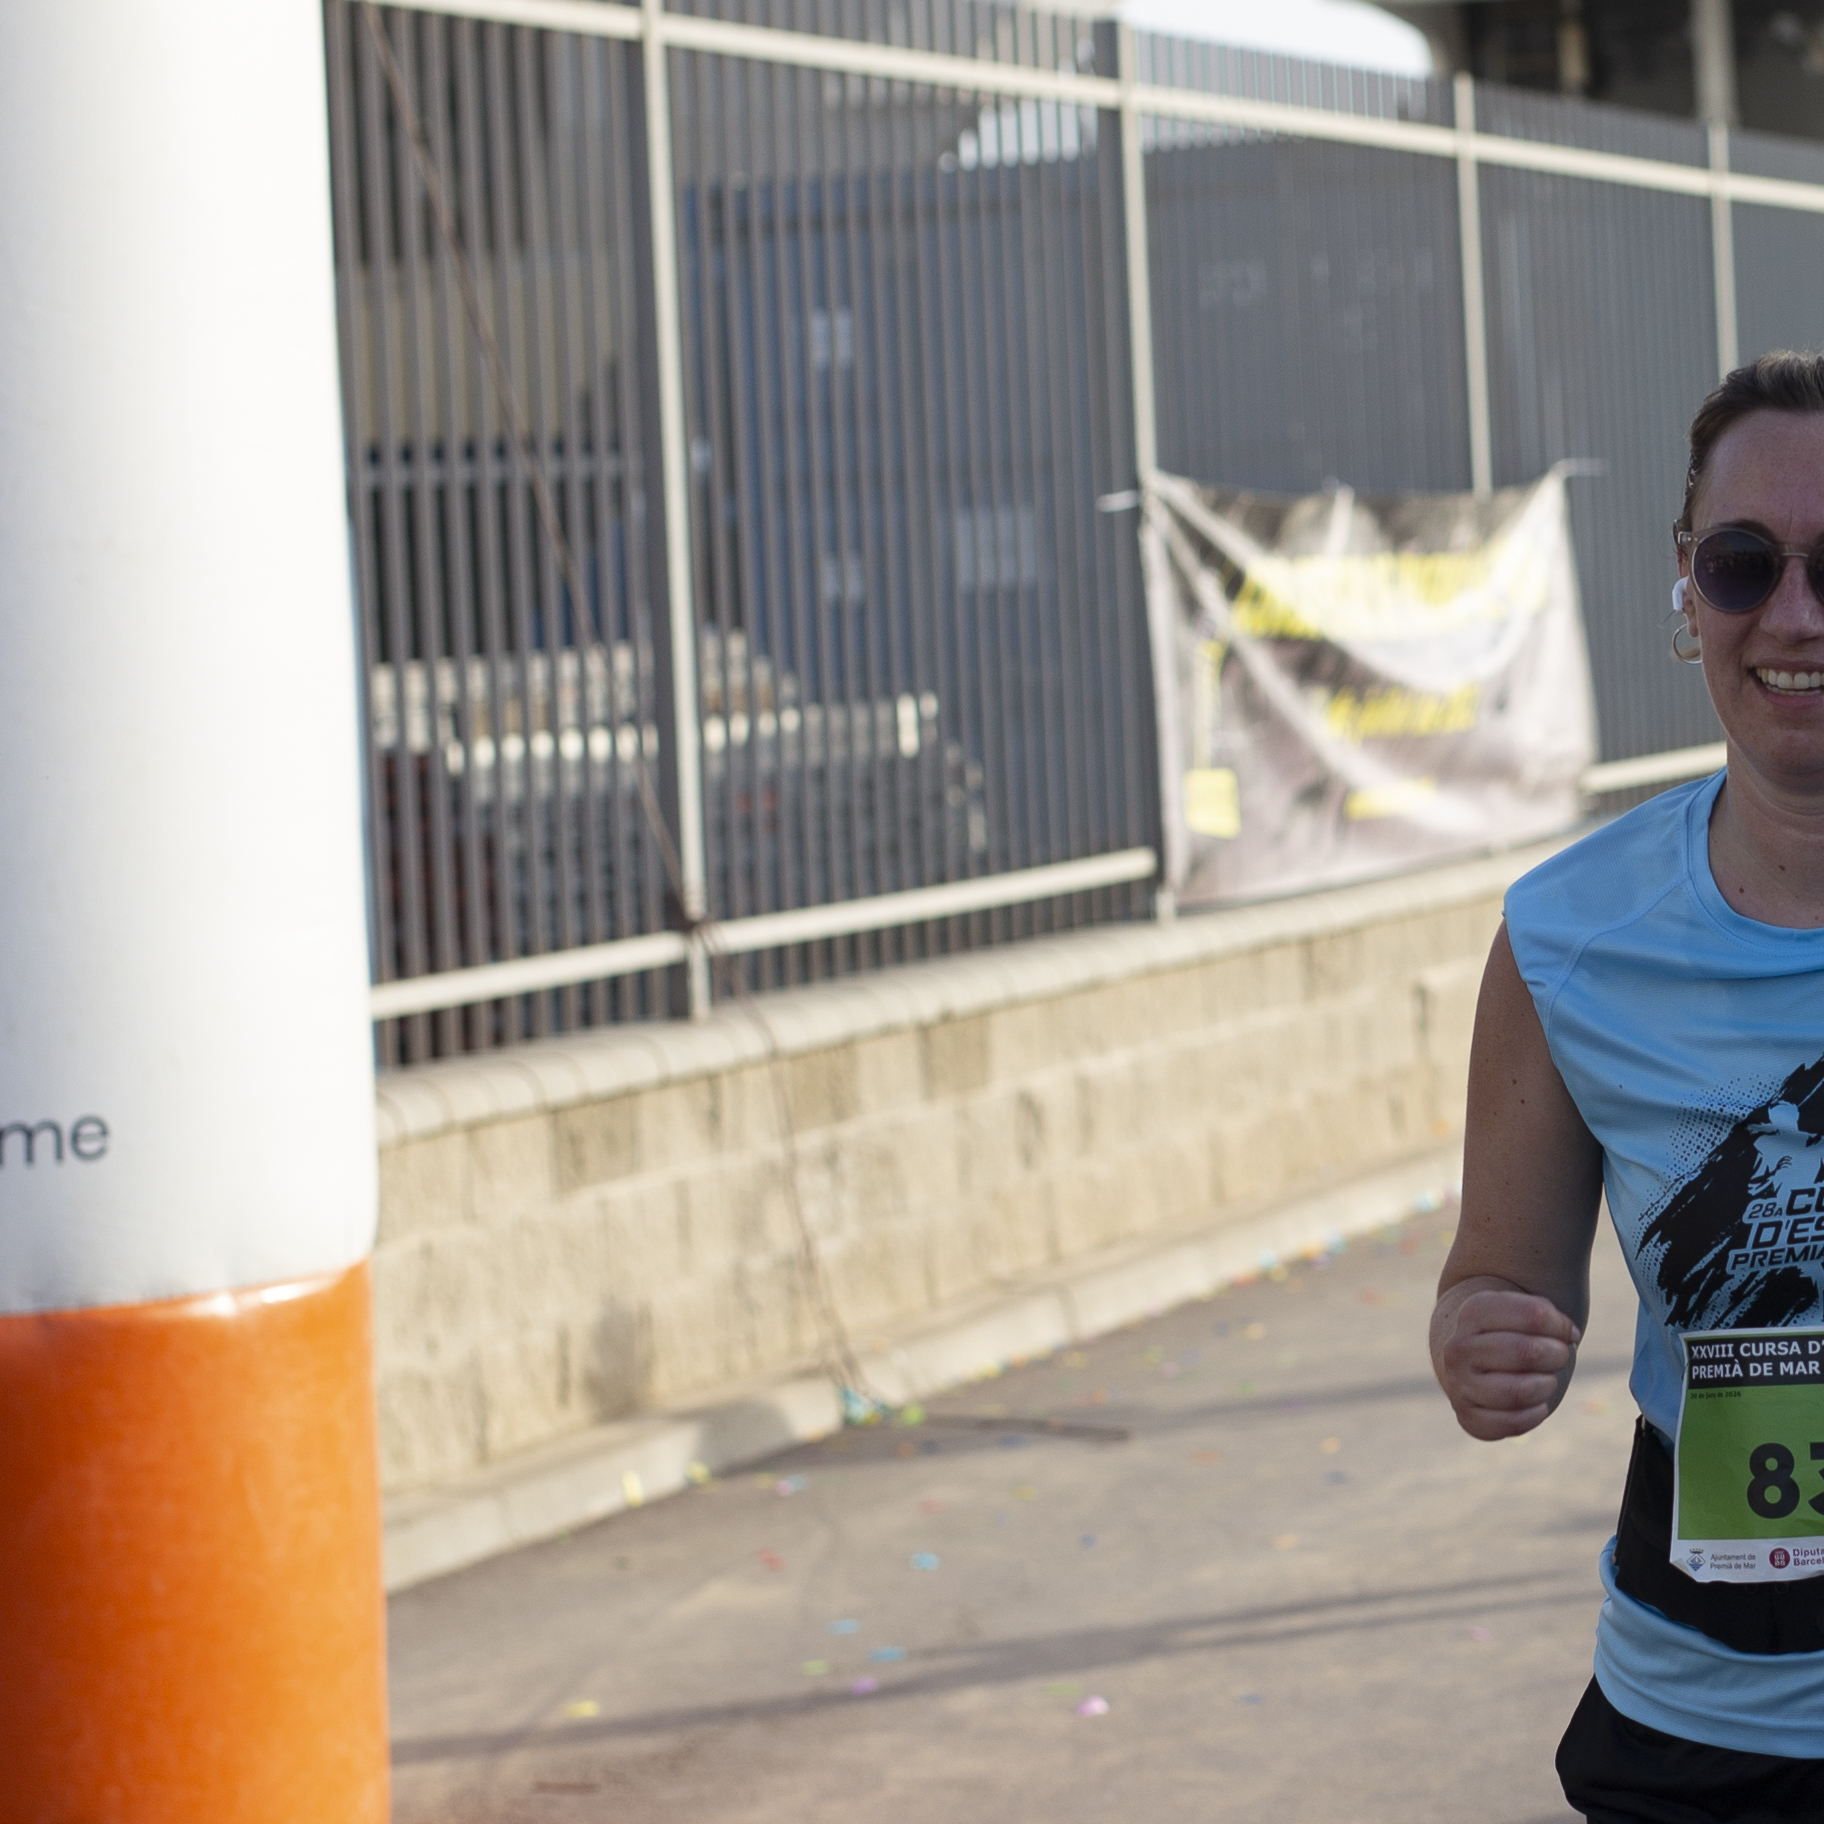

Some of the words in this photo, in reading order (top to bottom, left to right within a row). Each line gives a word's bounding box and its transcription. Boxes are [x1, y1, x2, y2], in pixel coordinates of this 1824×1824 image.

[1691, 1343, 1734, 1359] XXVIII
[1739, 1341, 1802, 1357] CURSA
[1692, 1359, 1743, 1379] PREMIÀ
[1749, 1362, 1773, 1376] DE
[1780, 1360, 1821, 1375] MAR
[1710, 1554, 1747, 1562] Ajuntament
[1749, 1553, 1756, 1561] de
[1710, 1561, 1733, 1570] Premià
